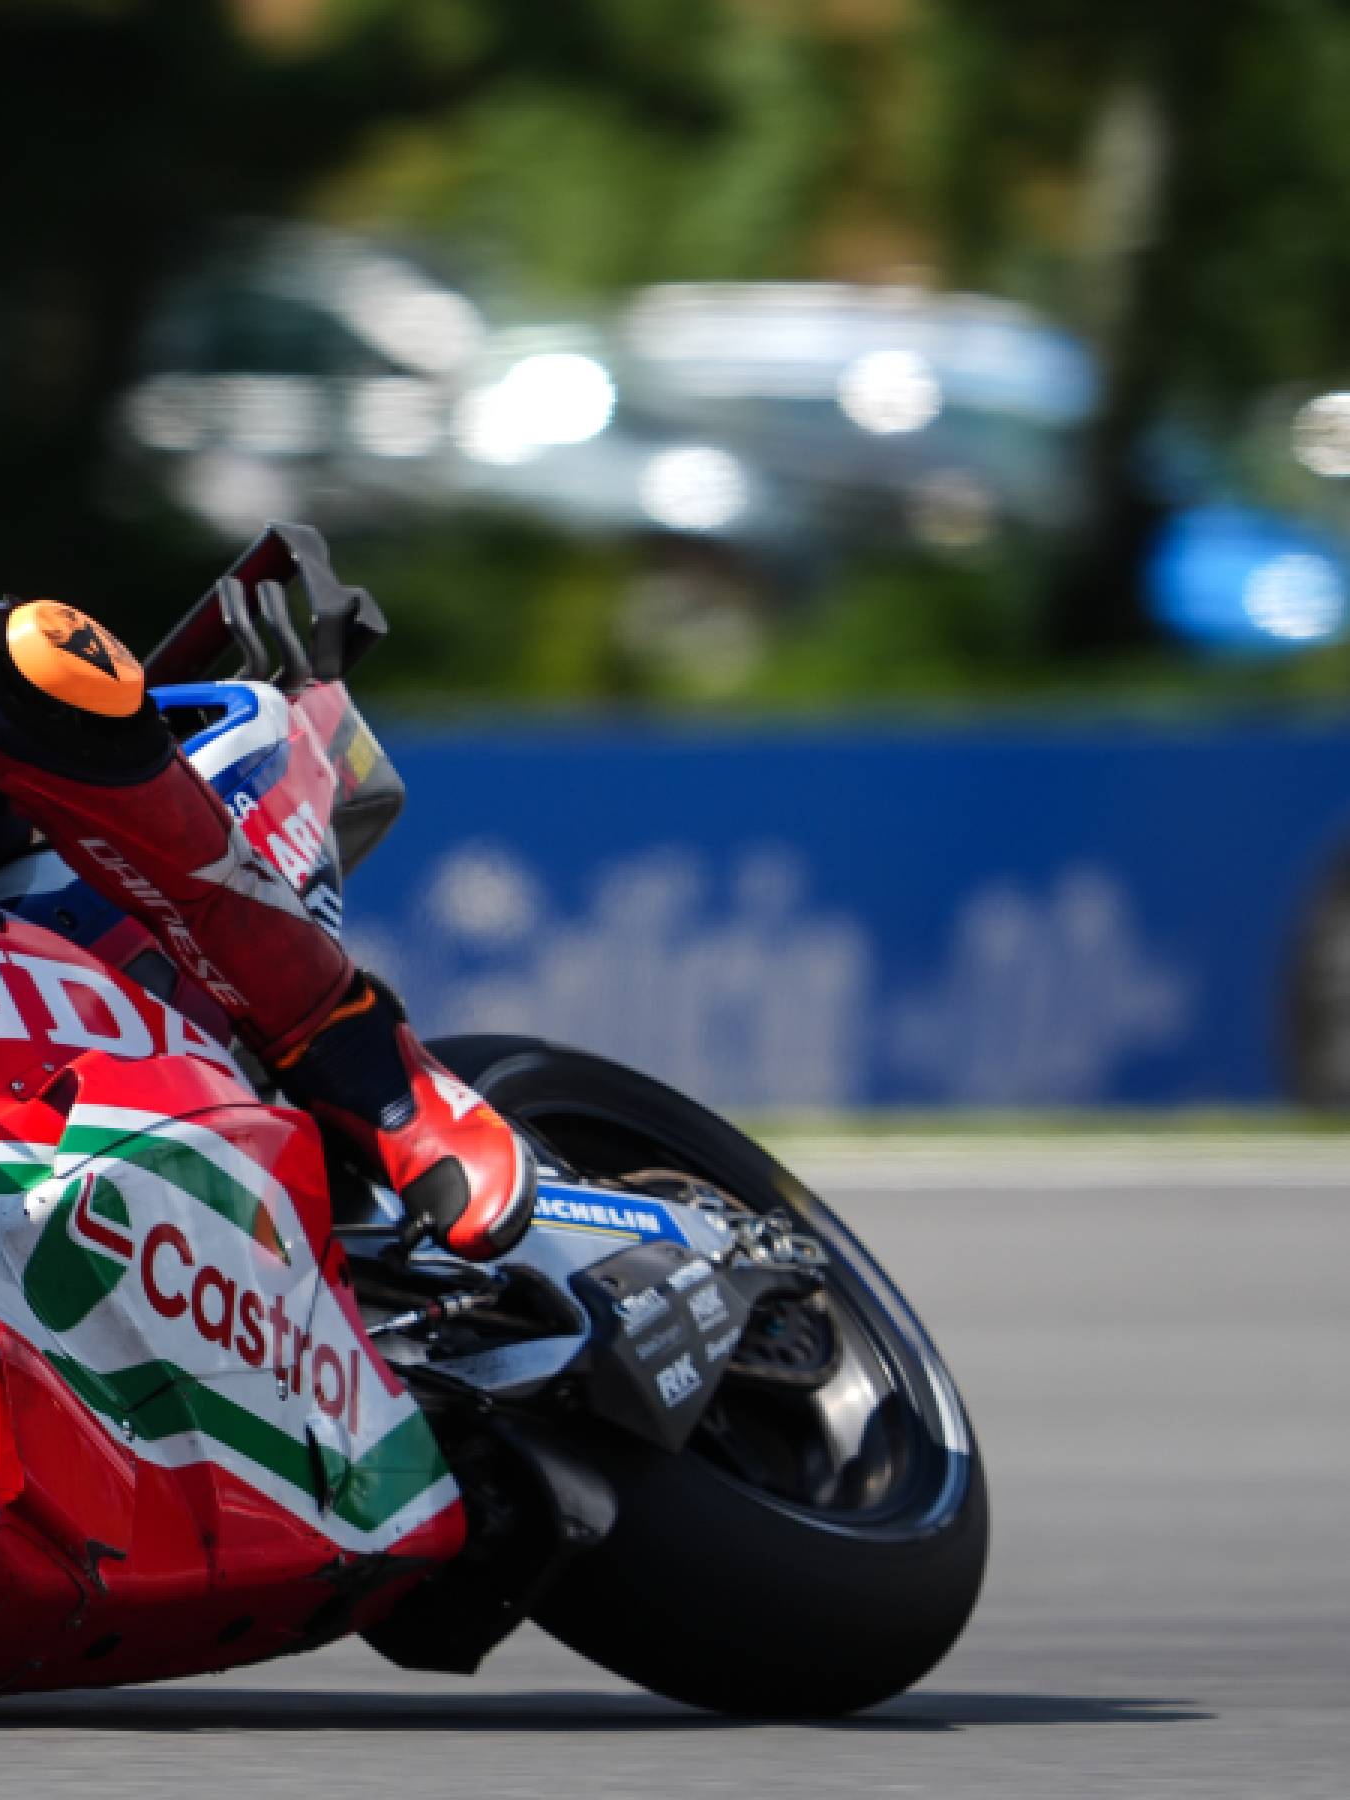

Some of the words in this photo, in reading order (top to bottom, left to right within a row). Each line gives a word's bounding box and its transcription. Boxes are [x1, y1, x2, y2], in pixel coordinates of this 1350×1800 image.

[77, 838, 251, 1007] DAINESE
[534, 1196, 661, 1234] ICHELIN
[141, 1221, 360, 1435] Castrol
[656, 1353, 702, 1406] RK
